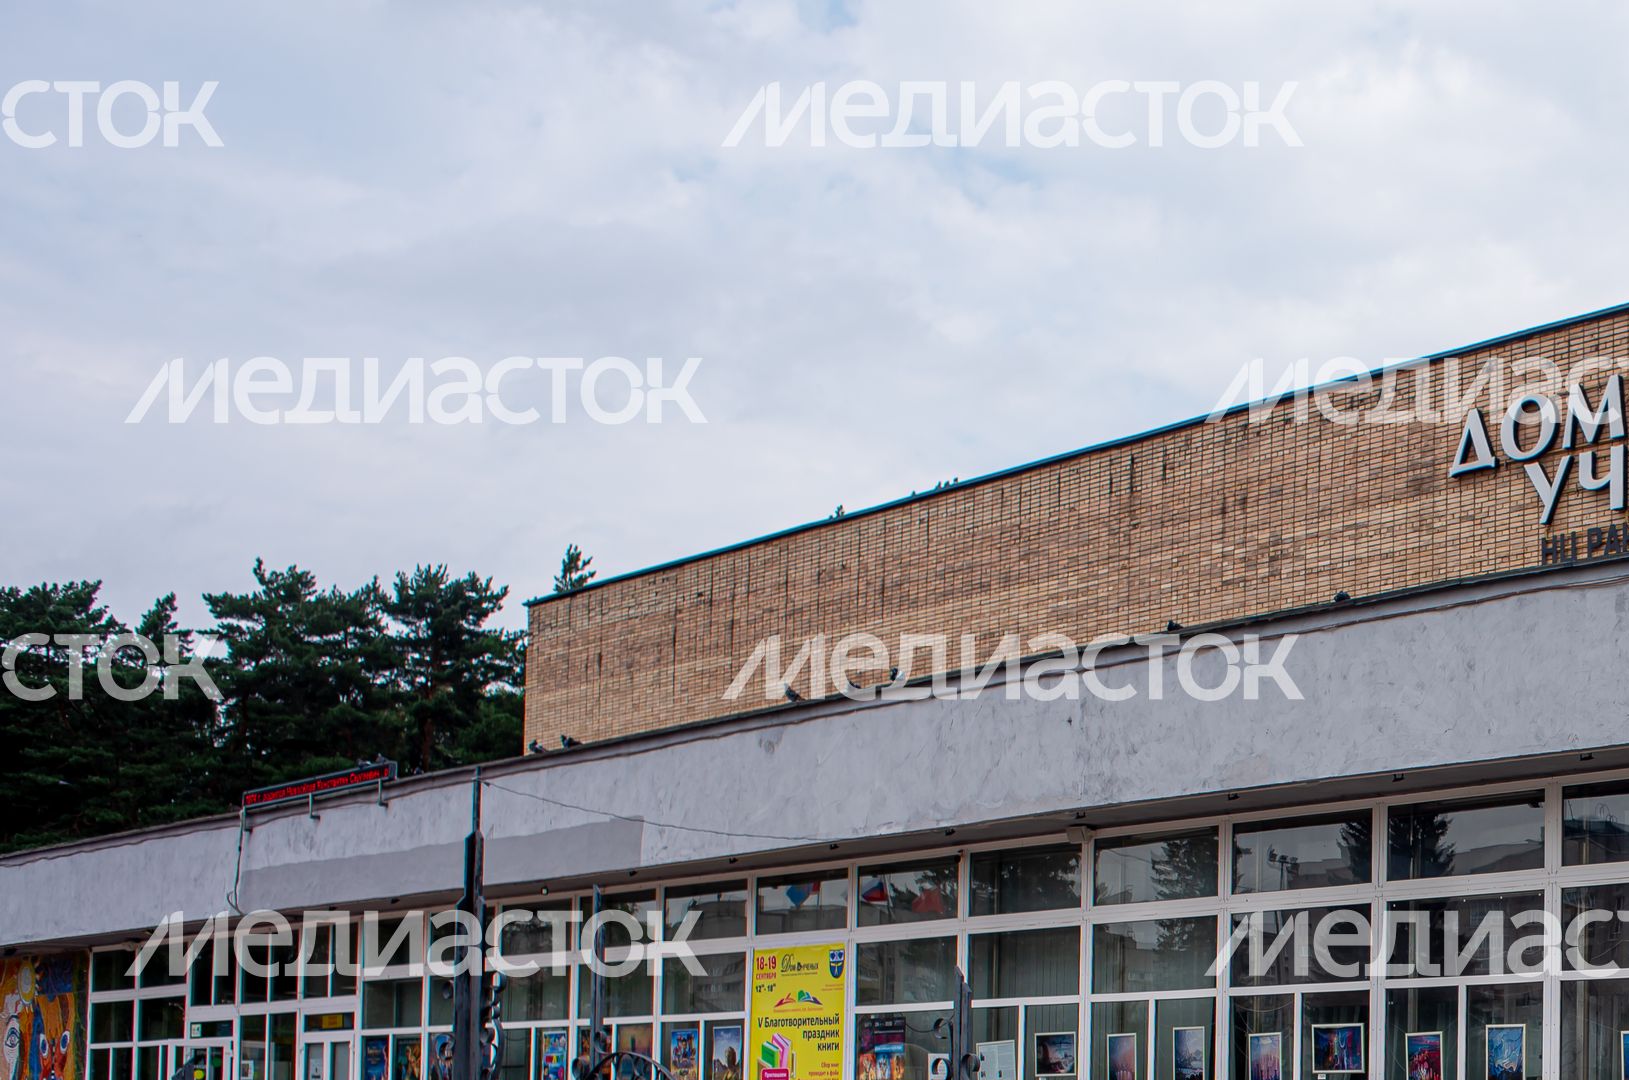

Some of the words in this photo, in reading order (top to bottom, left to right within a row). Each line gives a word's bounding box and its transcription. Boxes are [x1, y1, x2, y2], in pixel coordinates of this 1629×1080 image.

[1541, 529, 1577, 565] НЦ
[756, 955, 777, 970] 18-19
[764, 1013, 840, 1029] Благотворительный
[802, 1029, 840, 1041] праздник
[817, 1042, 840, 1052] книги
